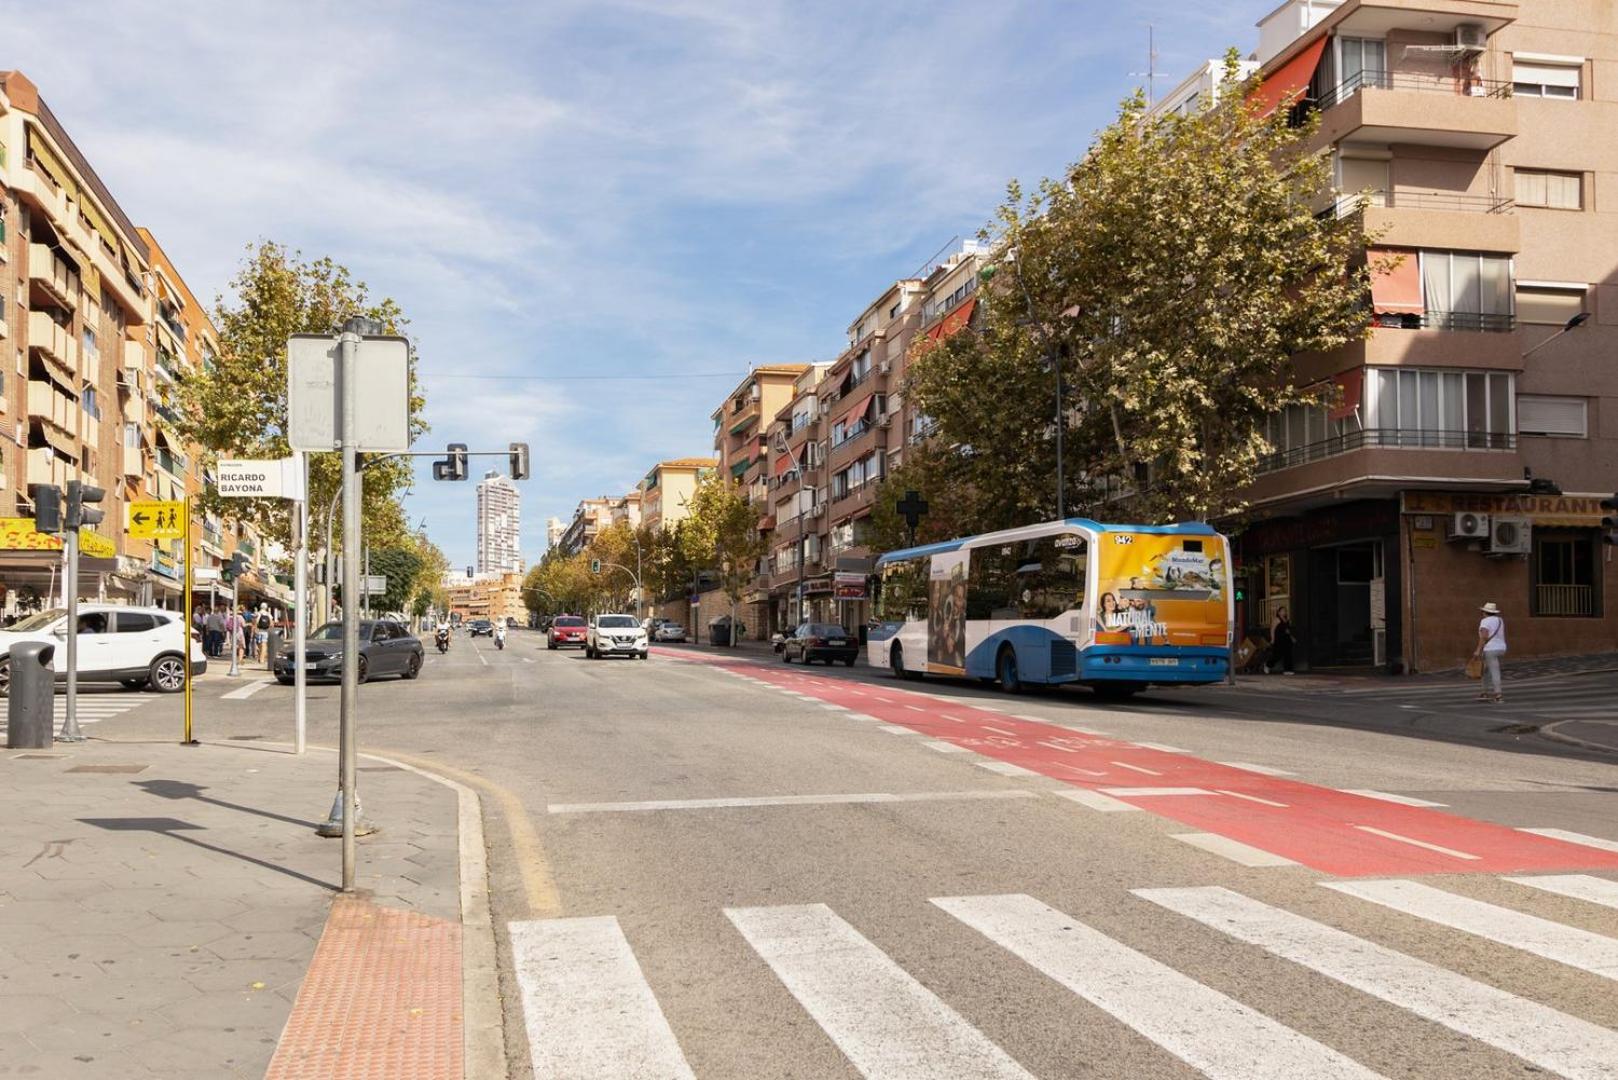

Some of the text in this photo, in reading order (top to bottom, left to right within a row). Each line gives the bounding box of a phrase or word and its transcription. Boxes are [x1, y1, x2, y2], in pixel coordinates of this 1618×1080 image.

[220, 473, 266, 482] RICARDO
[221, 484, 263, 492] BAYONA
[1115, 535, 1133, 545] 942
[1107, 609, 1151, 628] NATURAL
